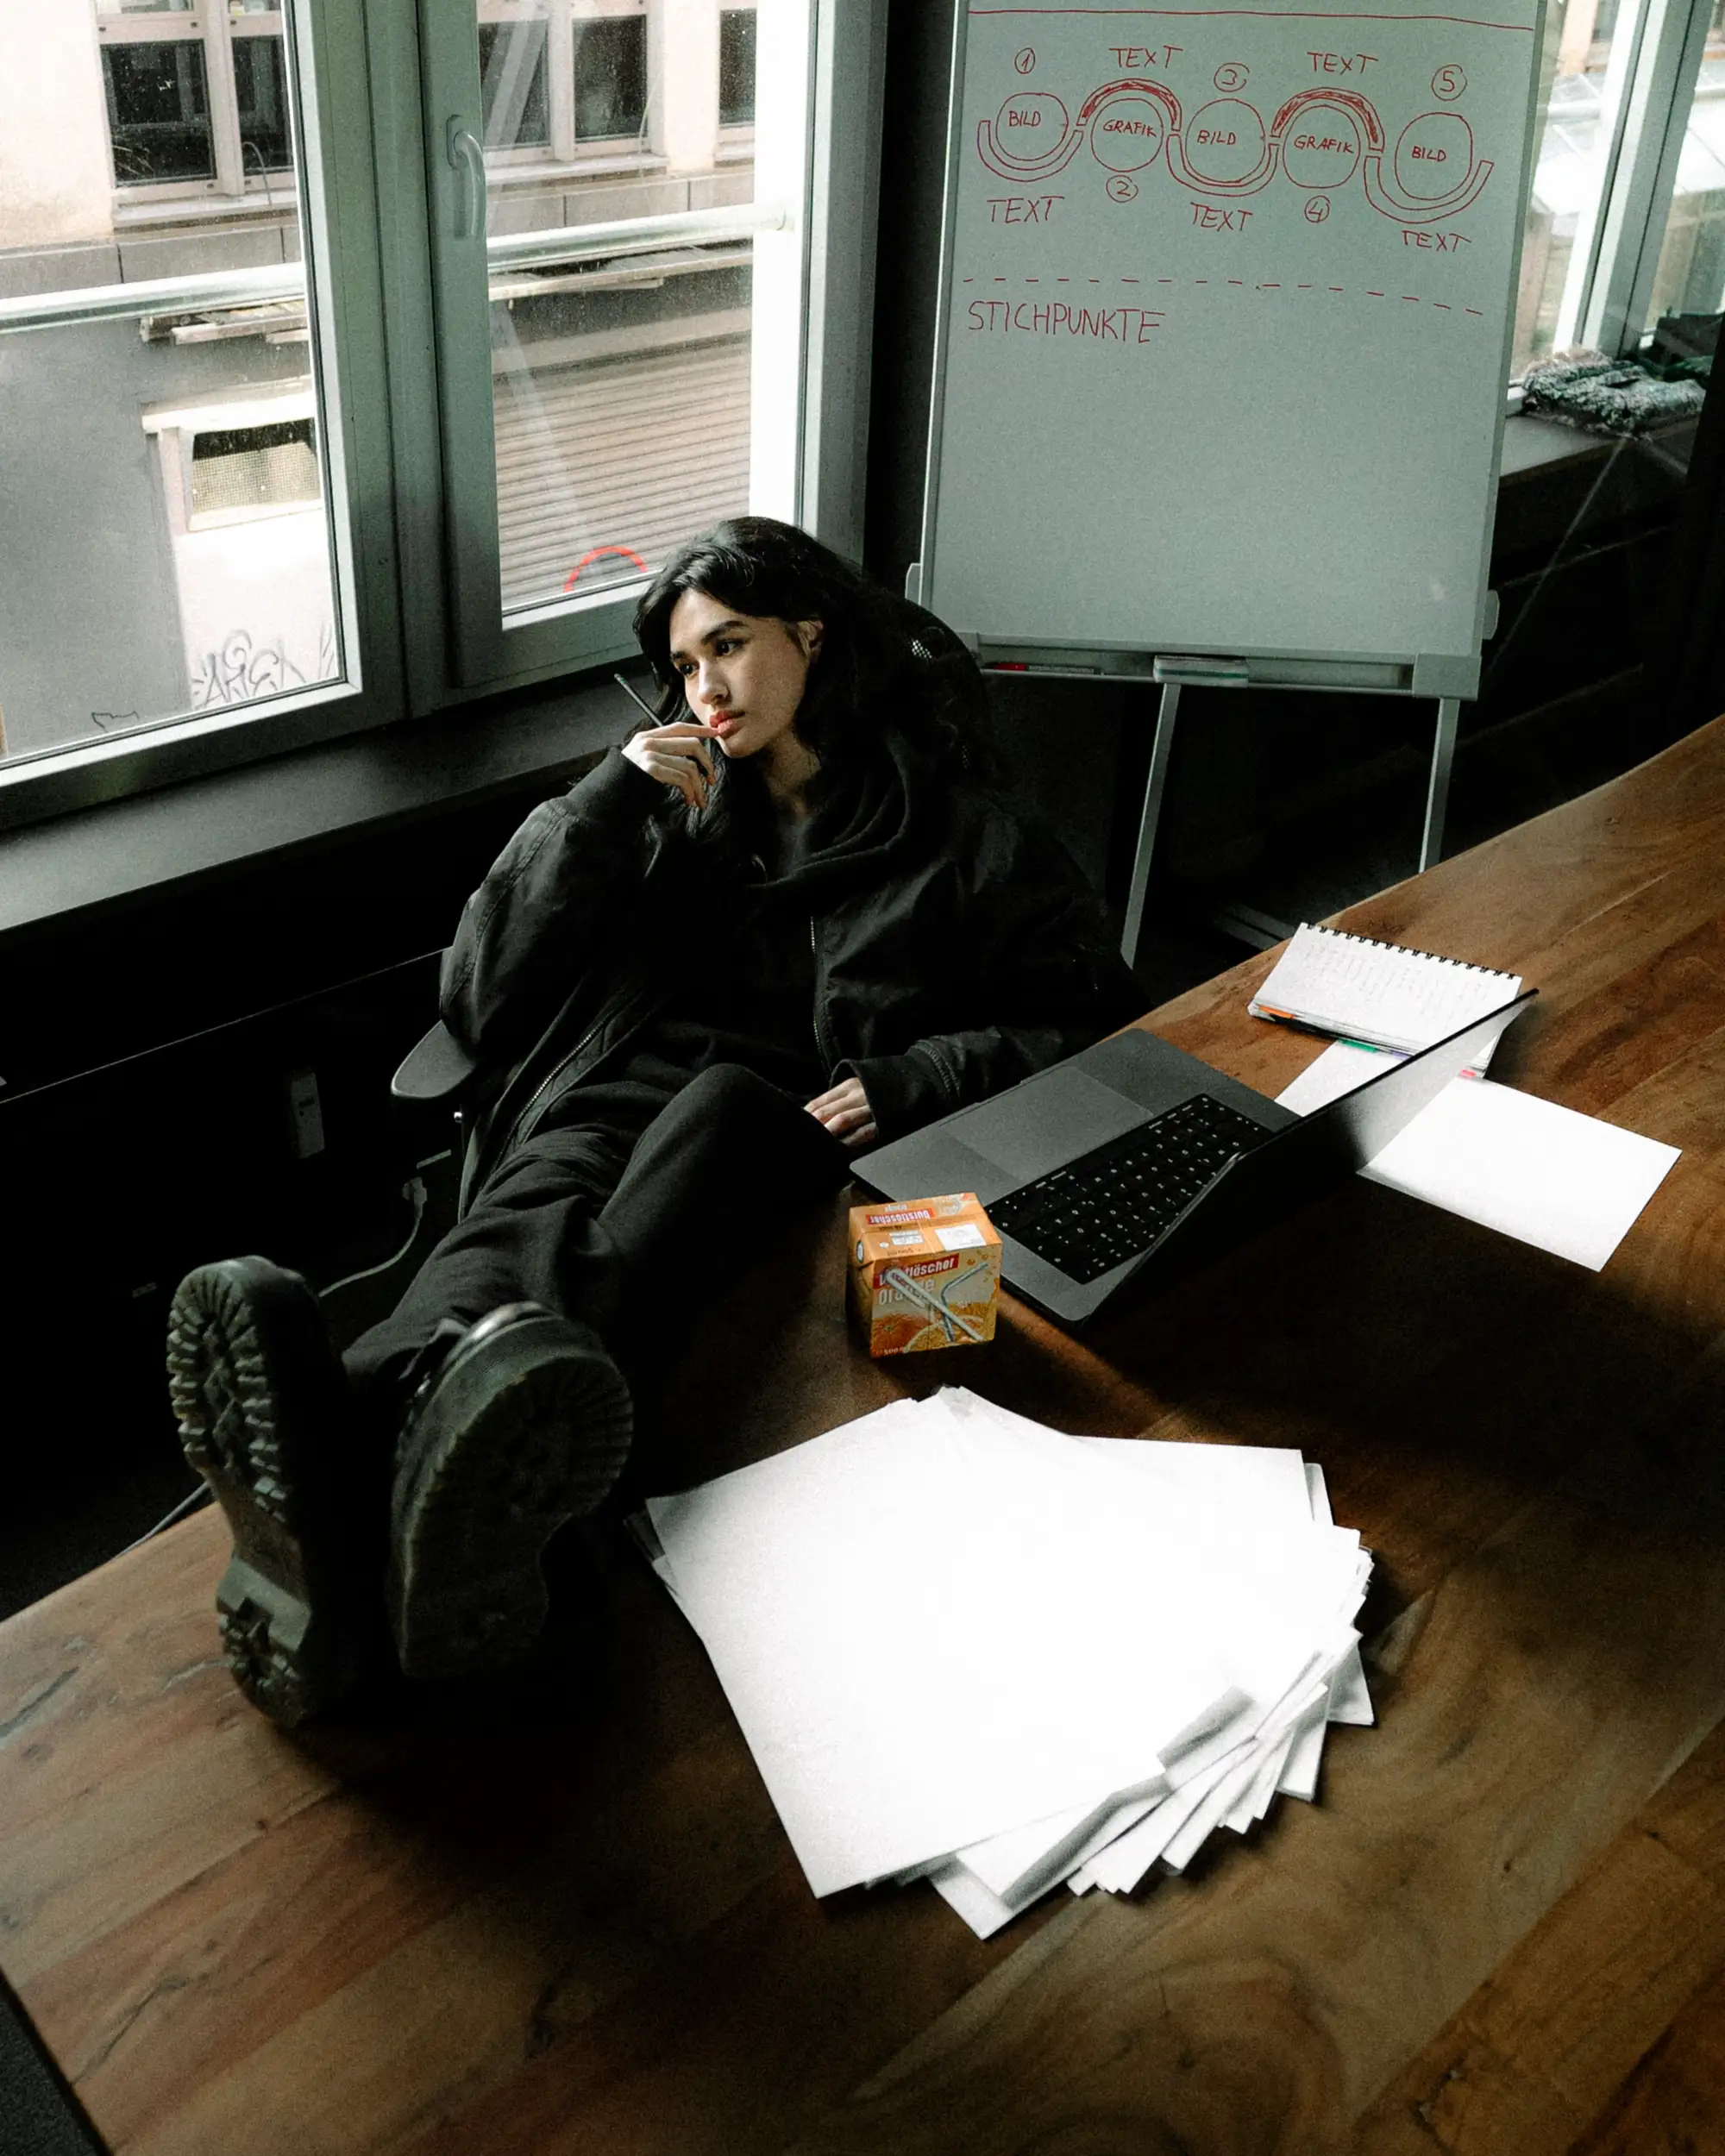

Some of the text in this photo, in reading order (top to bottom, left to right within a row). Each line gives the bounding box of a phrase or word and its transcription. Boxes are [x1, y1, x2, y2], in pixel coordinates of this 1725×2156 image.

[1109, 47, 1183, 69] TEXT
[1307, 52, 1378, 75] TEXT
[1008, 110, 1040, 128] BILD
[1103, 120, 1157, 138] GRAFIK
[1198, 129, 1237, 147] BILD
[1295, 135, 1354, 154] GRAFIK
[1411, 145, 1446, 163] BILD
[987, 195, 1064, 223] TEXT
[1190, 202, 1253, 231] TEXT
[1402, 229, 1471, 254] TEXT
[969, 299, 1165, 344] STICHPUNKTE
